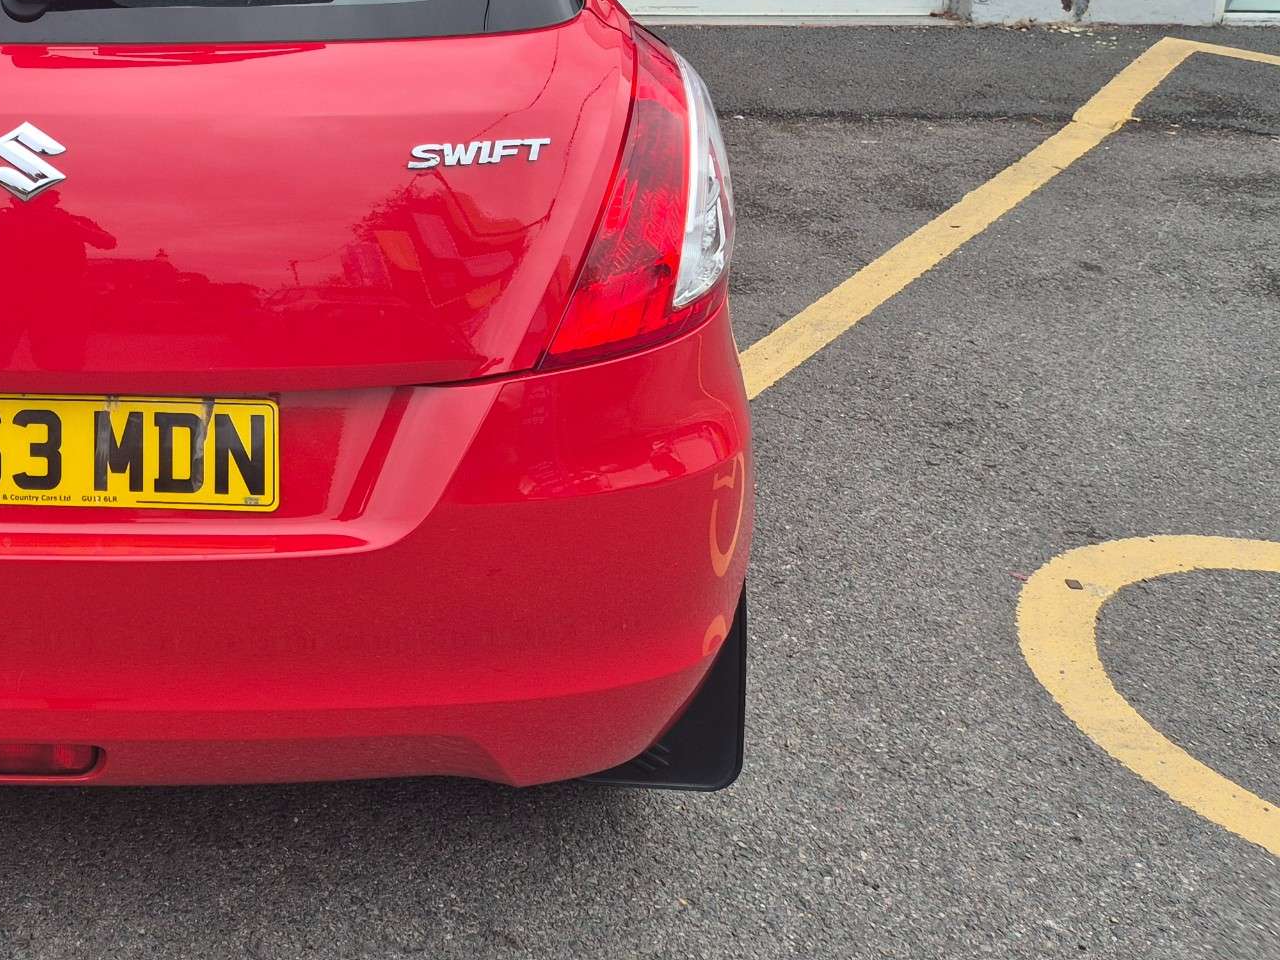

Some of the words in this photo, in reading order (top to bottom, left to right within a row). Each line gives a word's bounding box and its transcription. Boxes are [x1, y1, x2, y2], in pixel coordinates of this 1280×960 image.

[407, 137, 551, 169] SWIFT
[93, 411, 266, 496] MDN
[10, 494, 39, 503] Country
[41, 494, 58, 502] Cars
